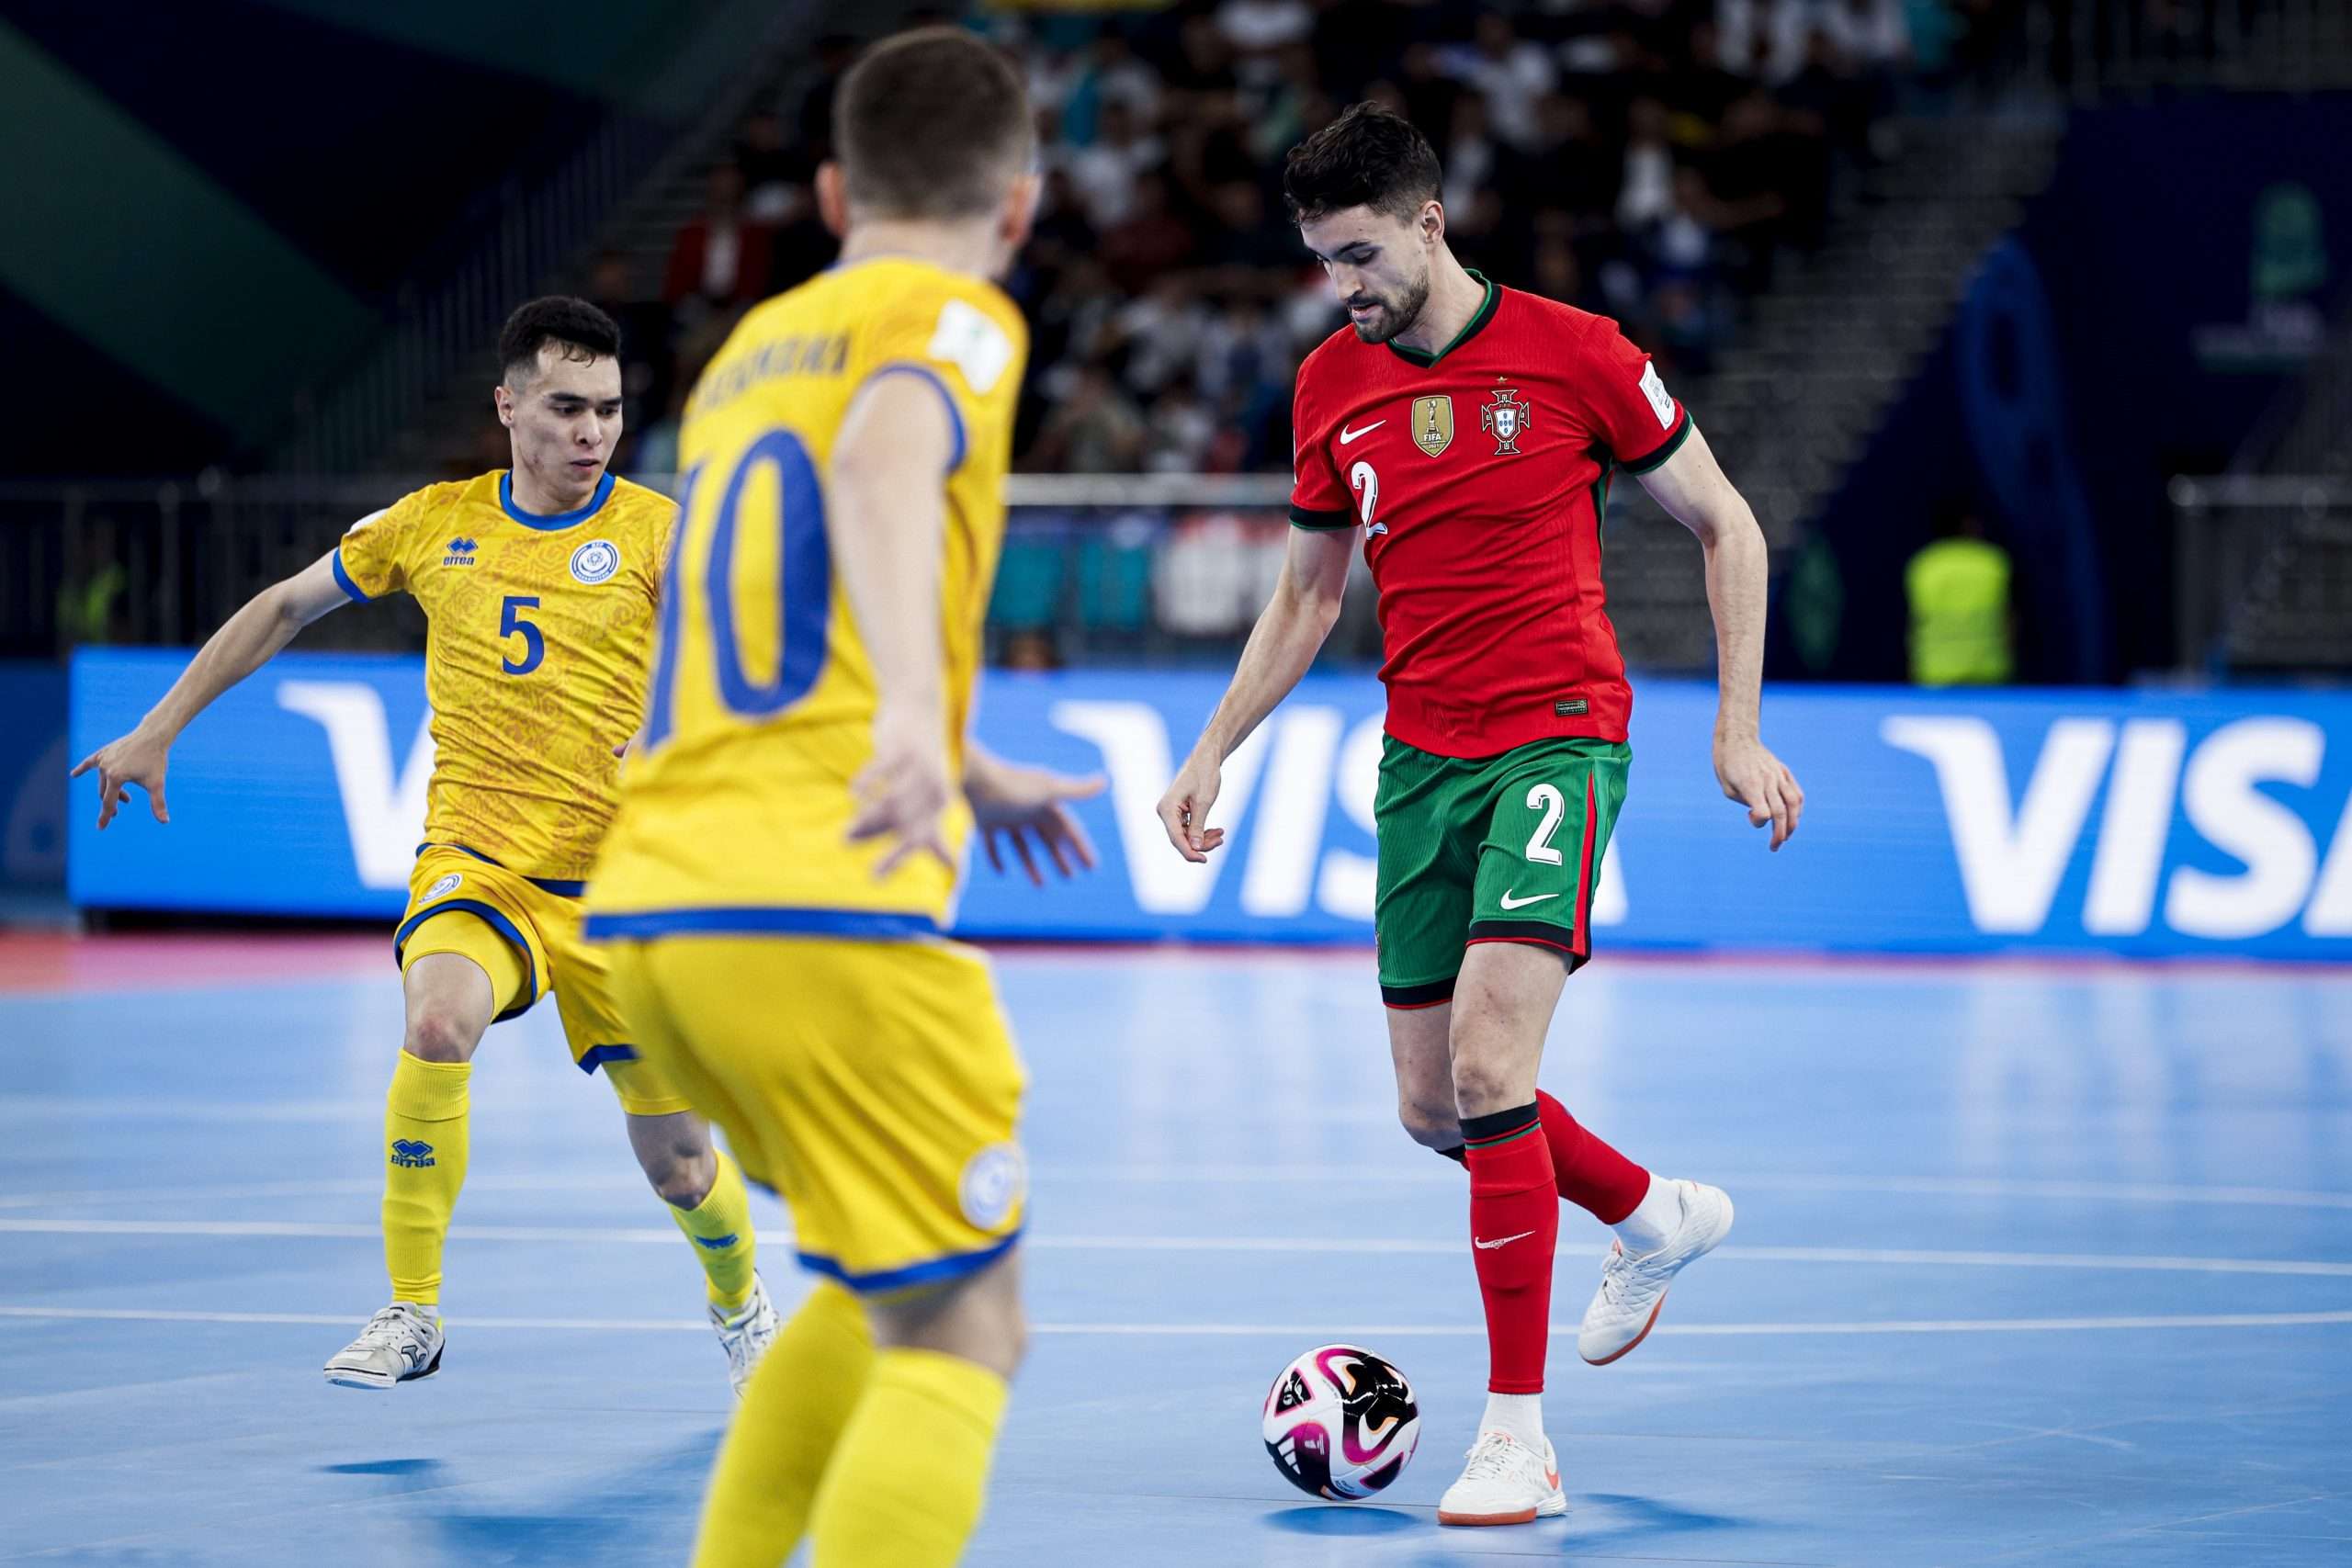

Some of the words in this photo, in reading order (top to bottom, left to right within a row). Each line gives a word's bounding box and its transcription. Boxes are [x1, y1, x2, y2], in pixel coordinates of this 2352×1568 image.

[1423, 434, 1442, 442] FIFA
[1351, 461, 1388, 540] 2
[645, 425, 832, 753] 10
[499, 596, 545, 675] 5
[1052, 702, 1628, 925] VI
[1525, 783, 1564, 866] 2
